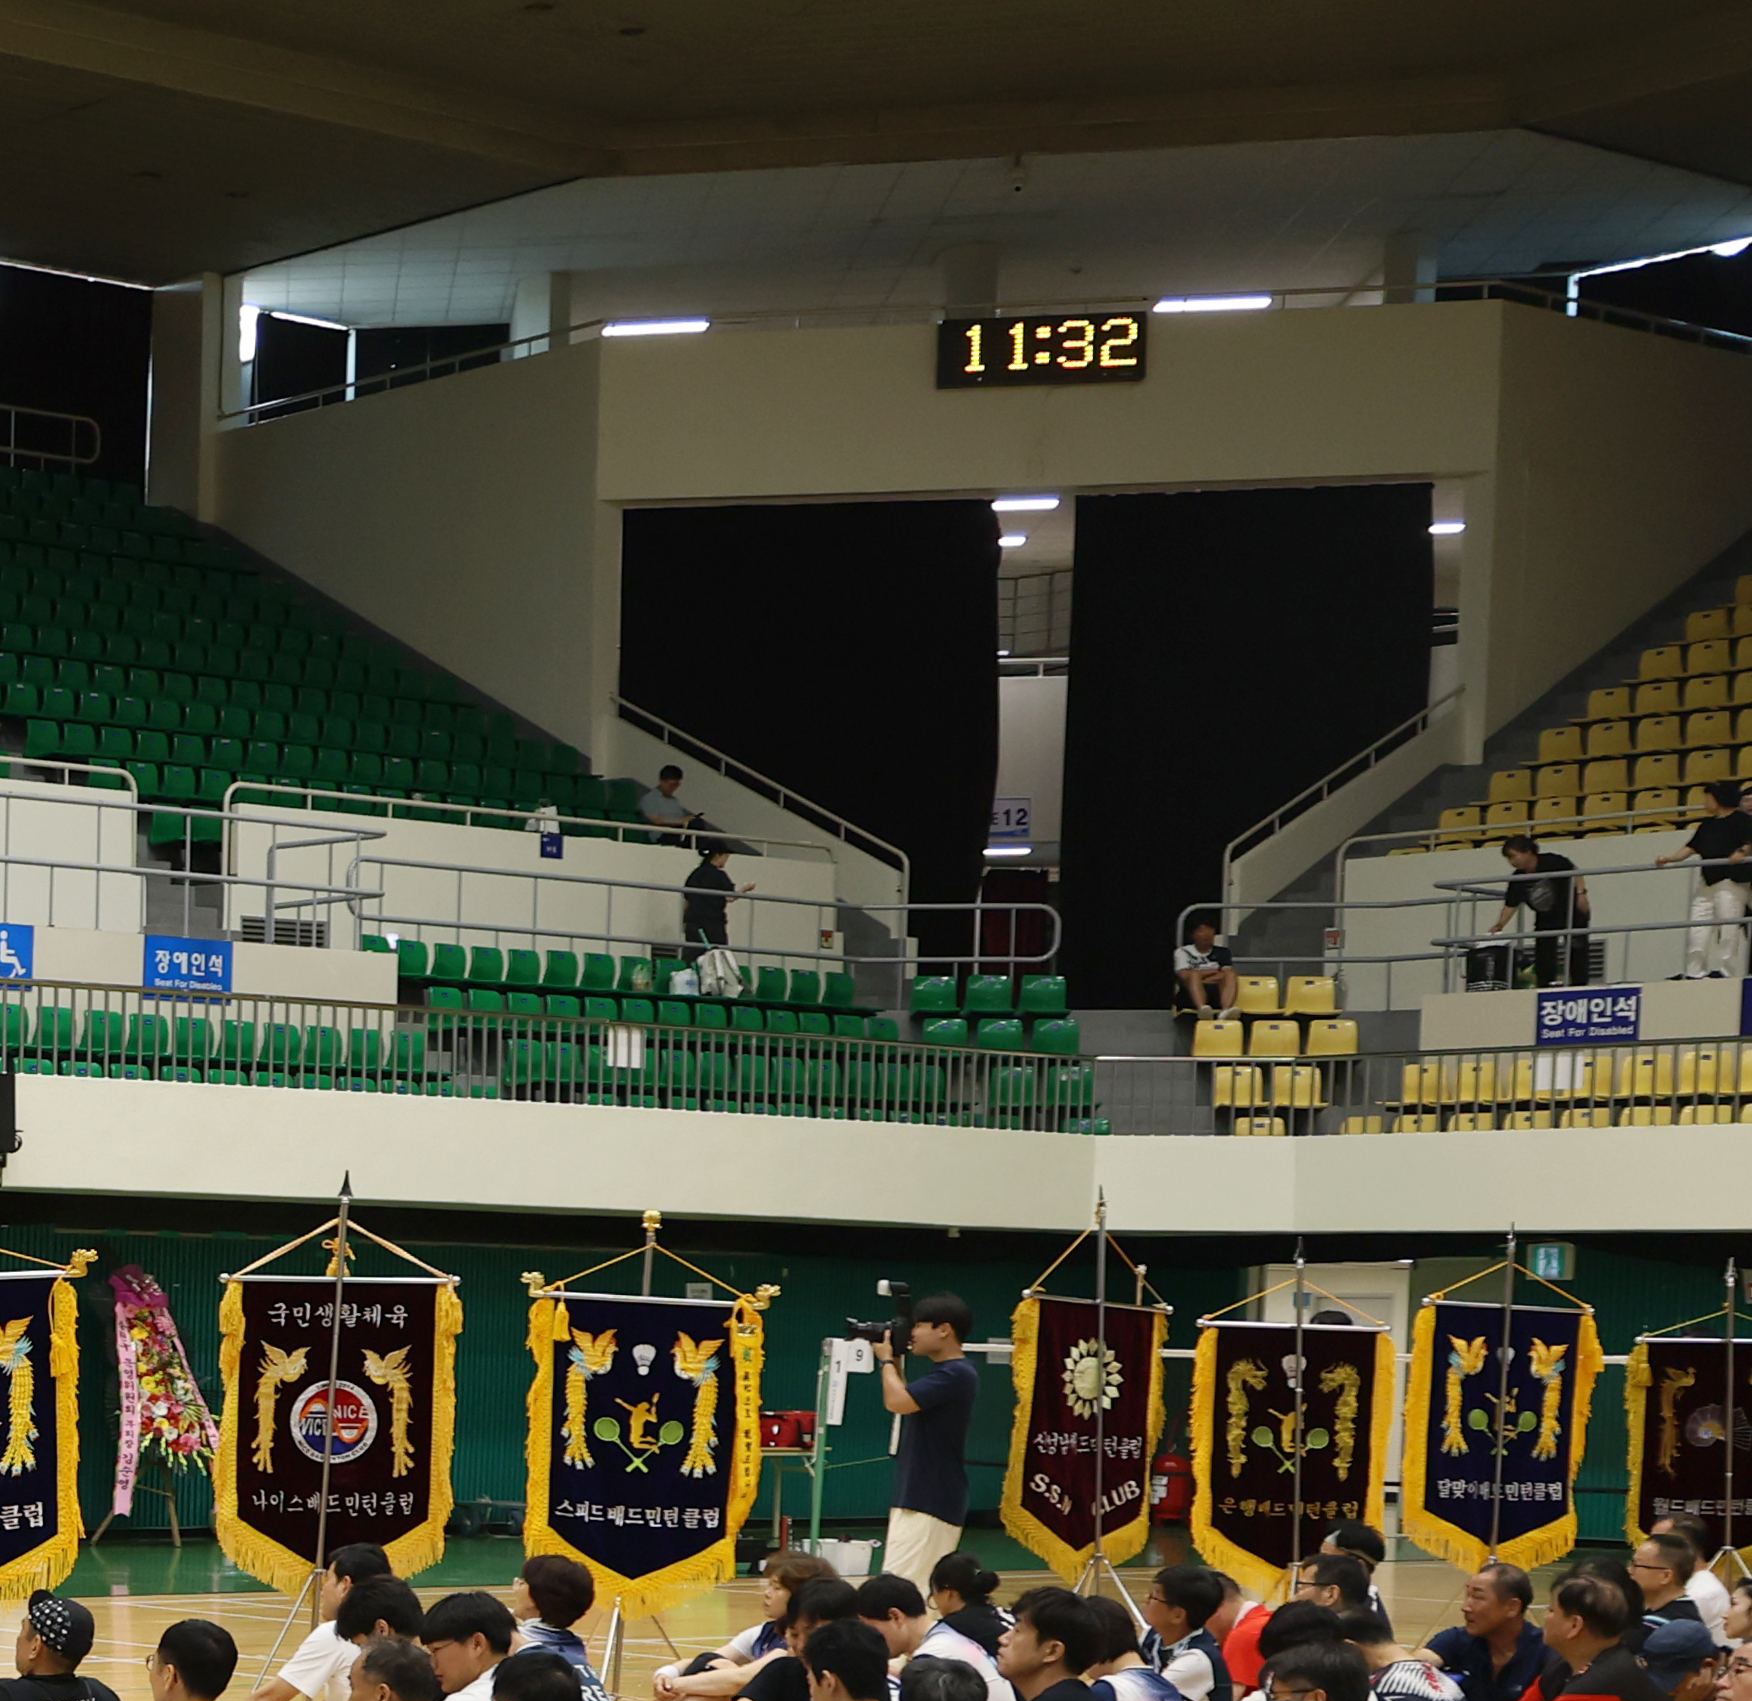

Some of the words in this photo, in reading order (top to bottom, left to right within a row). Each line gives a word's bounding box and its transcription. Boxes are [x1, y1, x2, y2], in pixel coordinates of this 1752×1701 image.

[963, 317, 1139, 373] 11:32
[1003, 807, 1028, 826] 12
[154, 949, 224, 977] 장애인석
[1540, 993, 1638, 1026] 장애인석
[267, 1301, 409, 1328] 국민생활체육
[252, 1488, 415, 1517] 나이스배드민턴클럽
